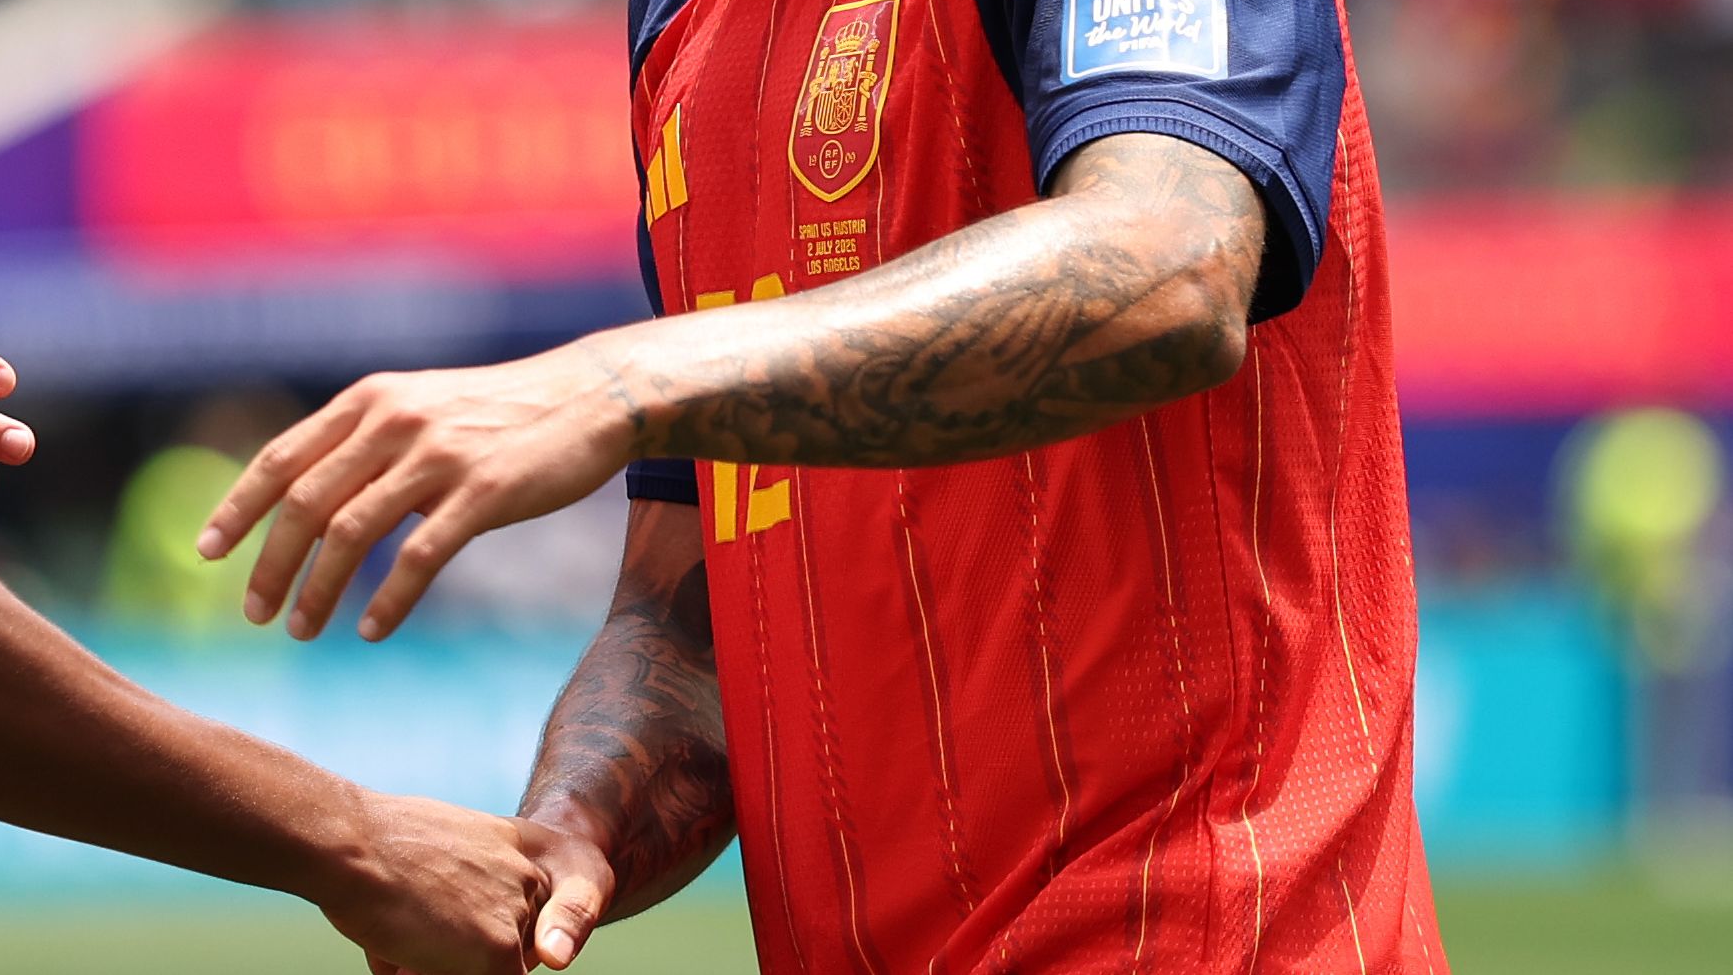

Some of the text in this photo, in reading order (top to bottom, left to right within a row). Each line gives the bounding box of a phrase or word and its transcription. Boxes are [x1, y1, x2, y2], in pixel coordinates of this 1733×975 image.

[1084, 21, 1128, 46] the
[799, 224, 819, 240] SPAIN
[833, 218, 866, 236] AUSTRIA
[807, 238, 857, 257] 2 JULY 2026
[807, 256, 860, 275] LOS ANGELES
